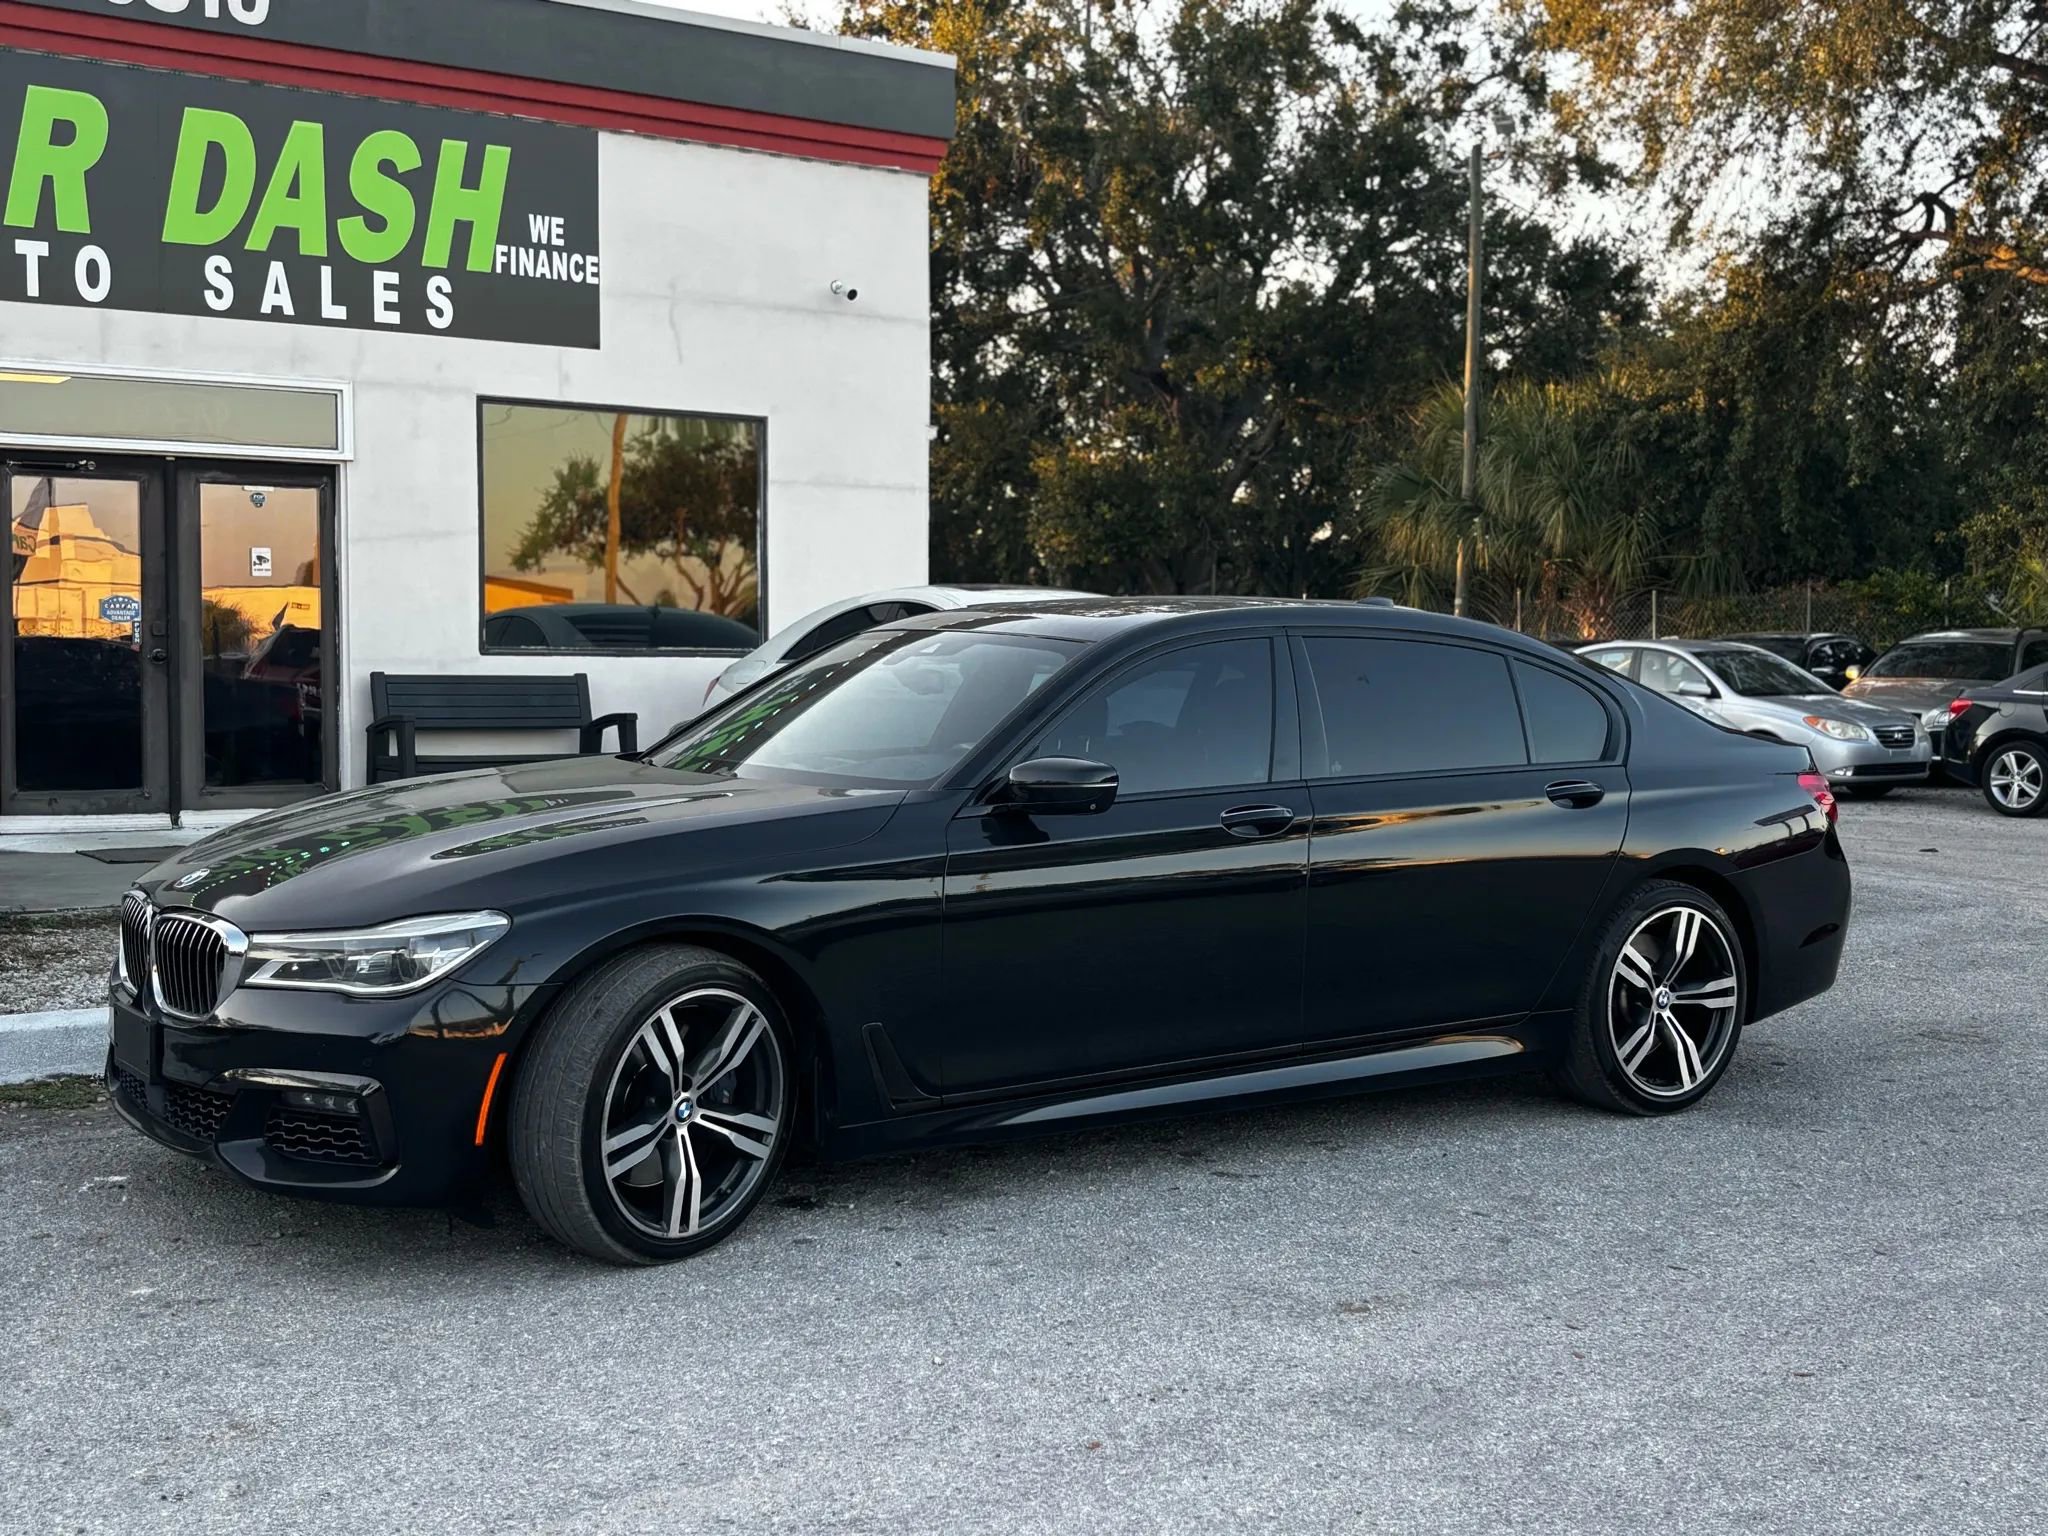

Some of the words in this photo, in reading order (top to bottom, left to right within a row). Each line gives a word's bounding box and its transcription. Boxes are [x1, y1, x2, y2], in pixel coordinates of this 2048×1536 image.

[3, 84, 109, 234] R
[161, 106, 512, 273] DASH
[528, 213, 565, 246] WE
[14, 238, 112, 303] TO
[203, 254, 454, 329] SALES
[495, 244, 600, 285] FINANCE
